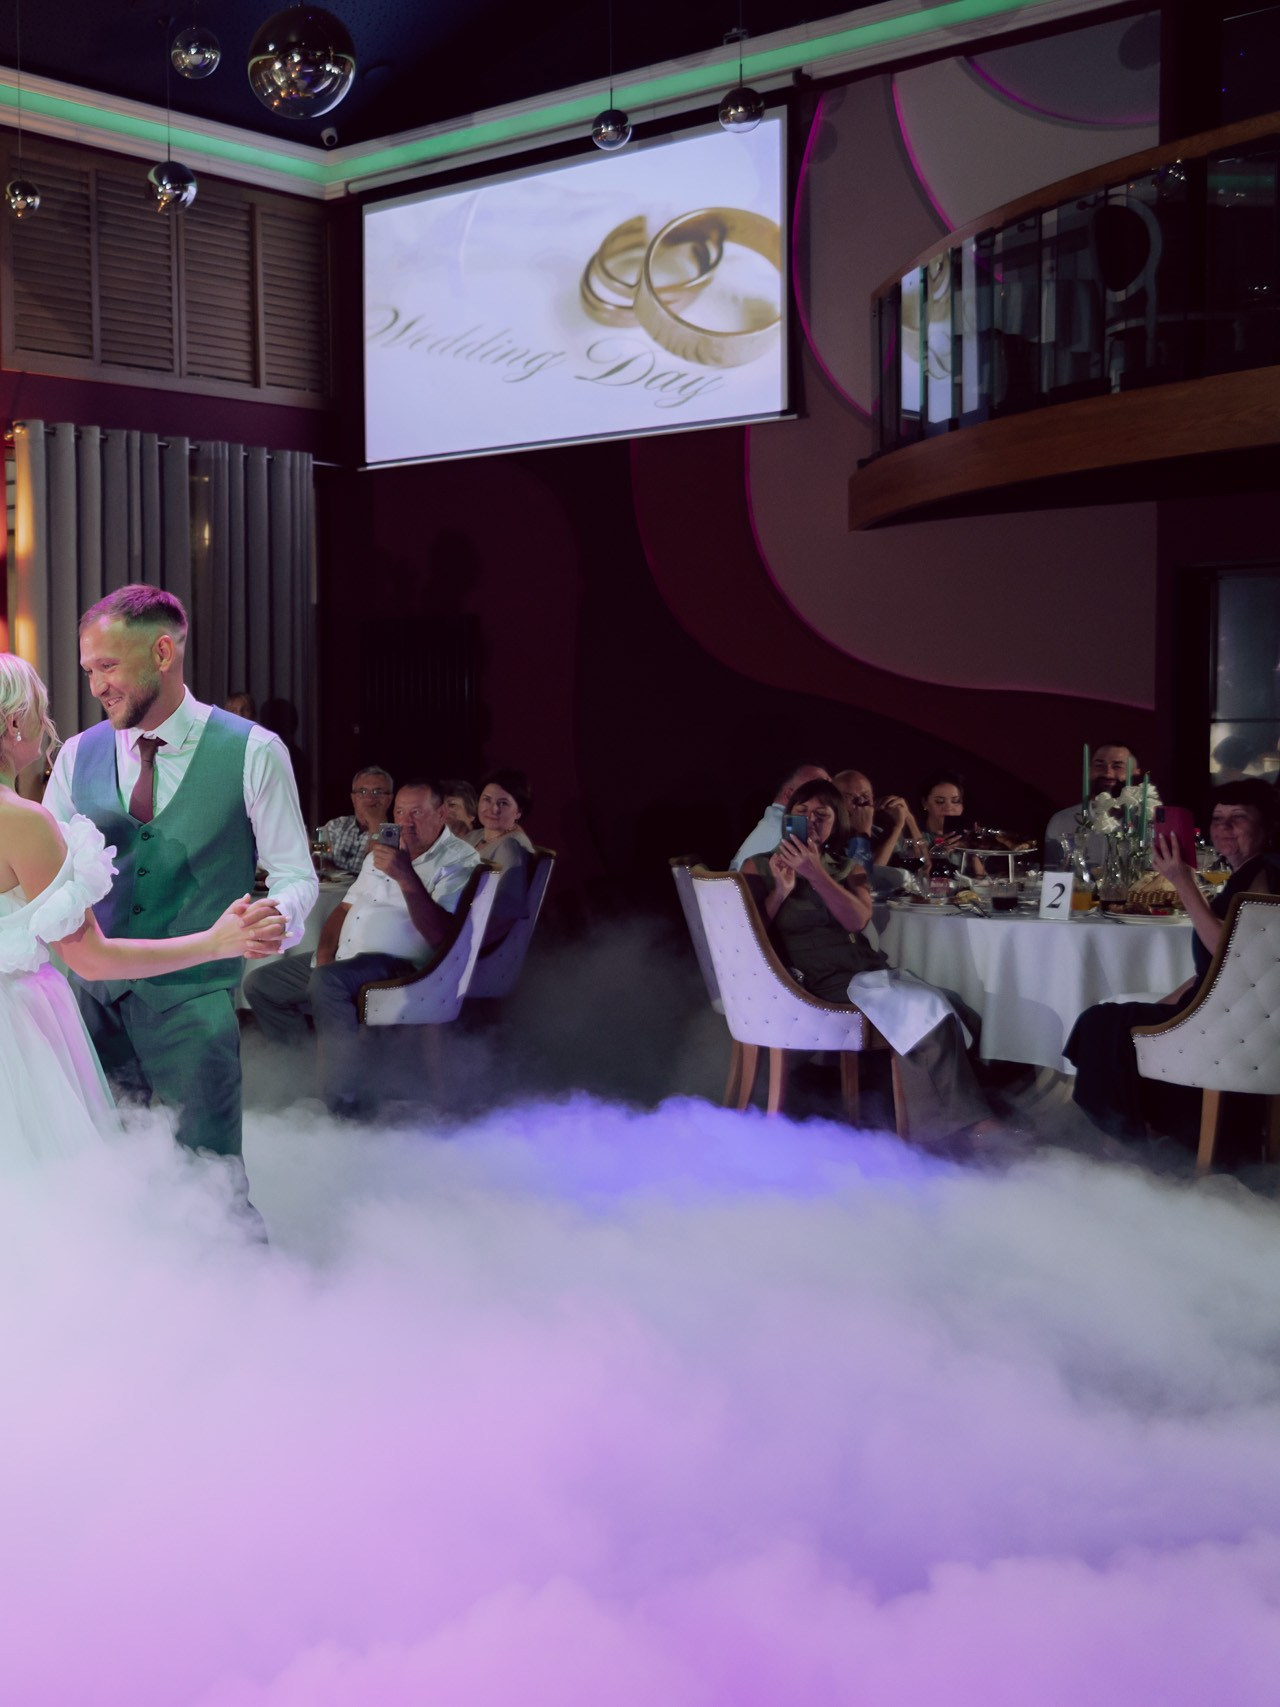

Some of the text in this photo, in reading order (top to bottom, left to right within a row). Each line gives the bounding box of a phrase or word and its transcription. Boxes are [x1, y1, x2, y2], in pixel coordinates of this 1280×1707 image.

[366, 304, 726, 409] Wedding Day
[1046, 882, 1066, 909] 2
